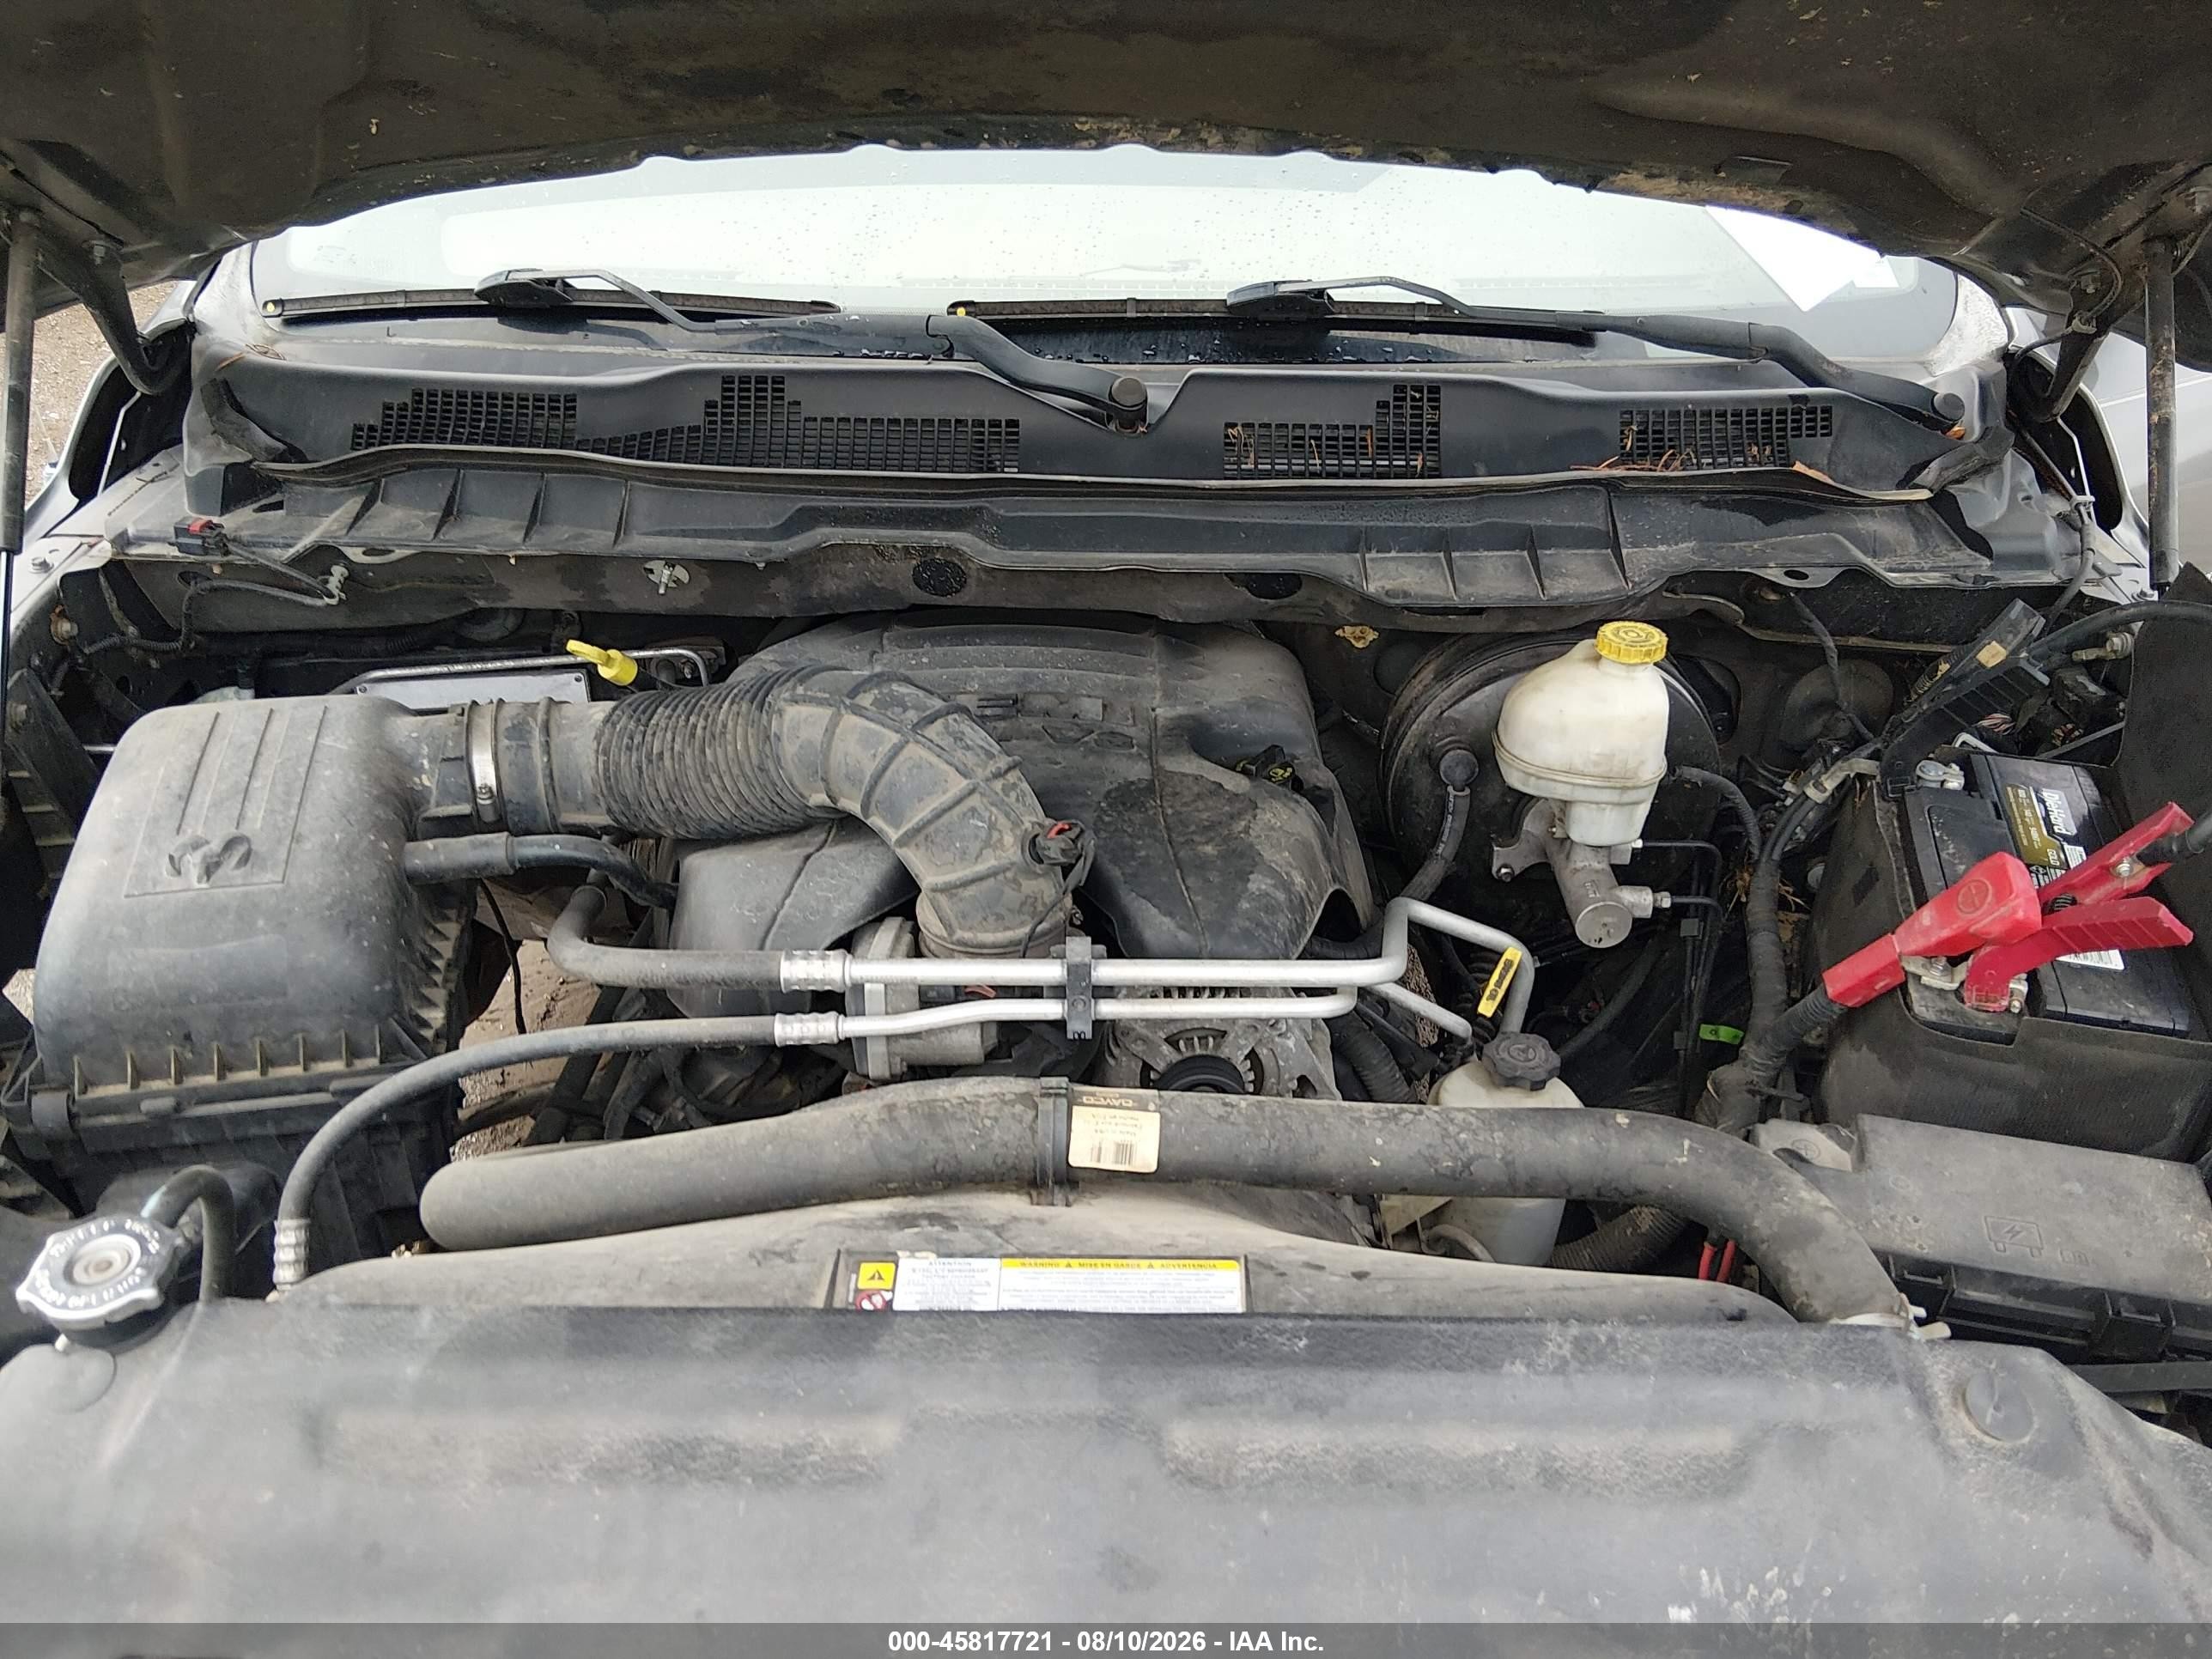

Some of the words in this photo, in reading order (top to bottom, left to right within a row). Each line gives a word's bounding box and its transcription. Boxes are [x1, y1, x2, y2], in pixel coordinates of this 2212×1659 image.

[2043, 791, 2072, 836] DieHard
[2047, 848, 2060, 866] GOLD
[1083, 1097, 1133, 1106] DAYCO
